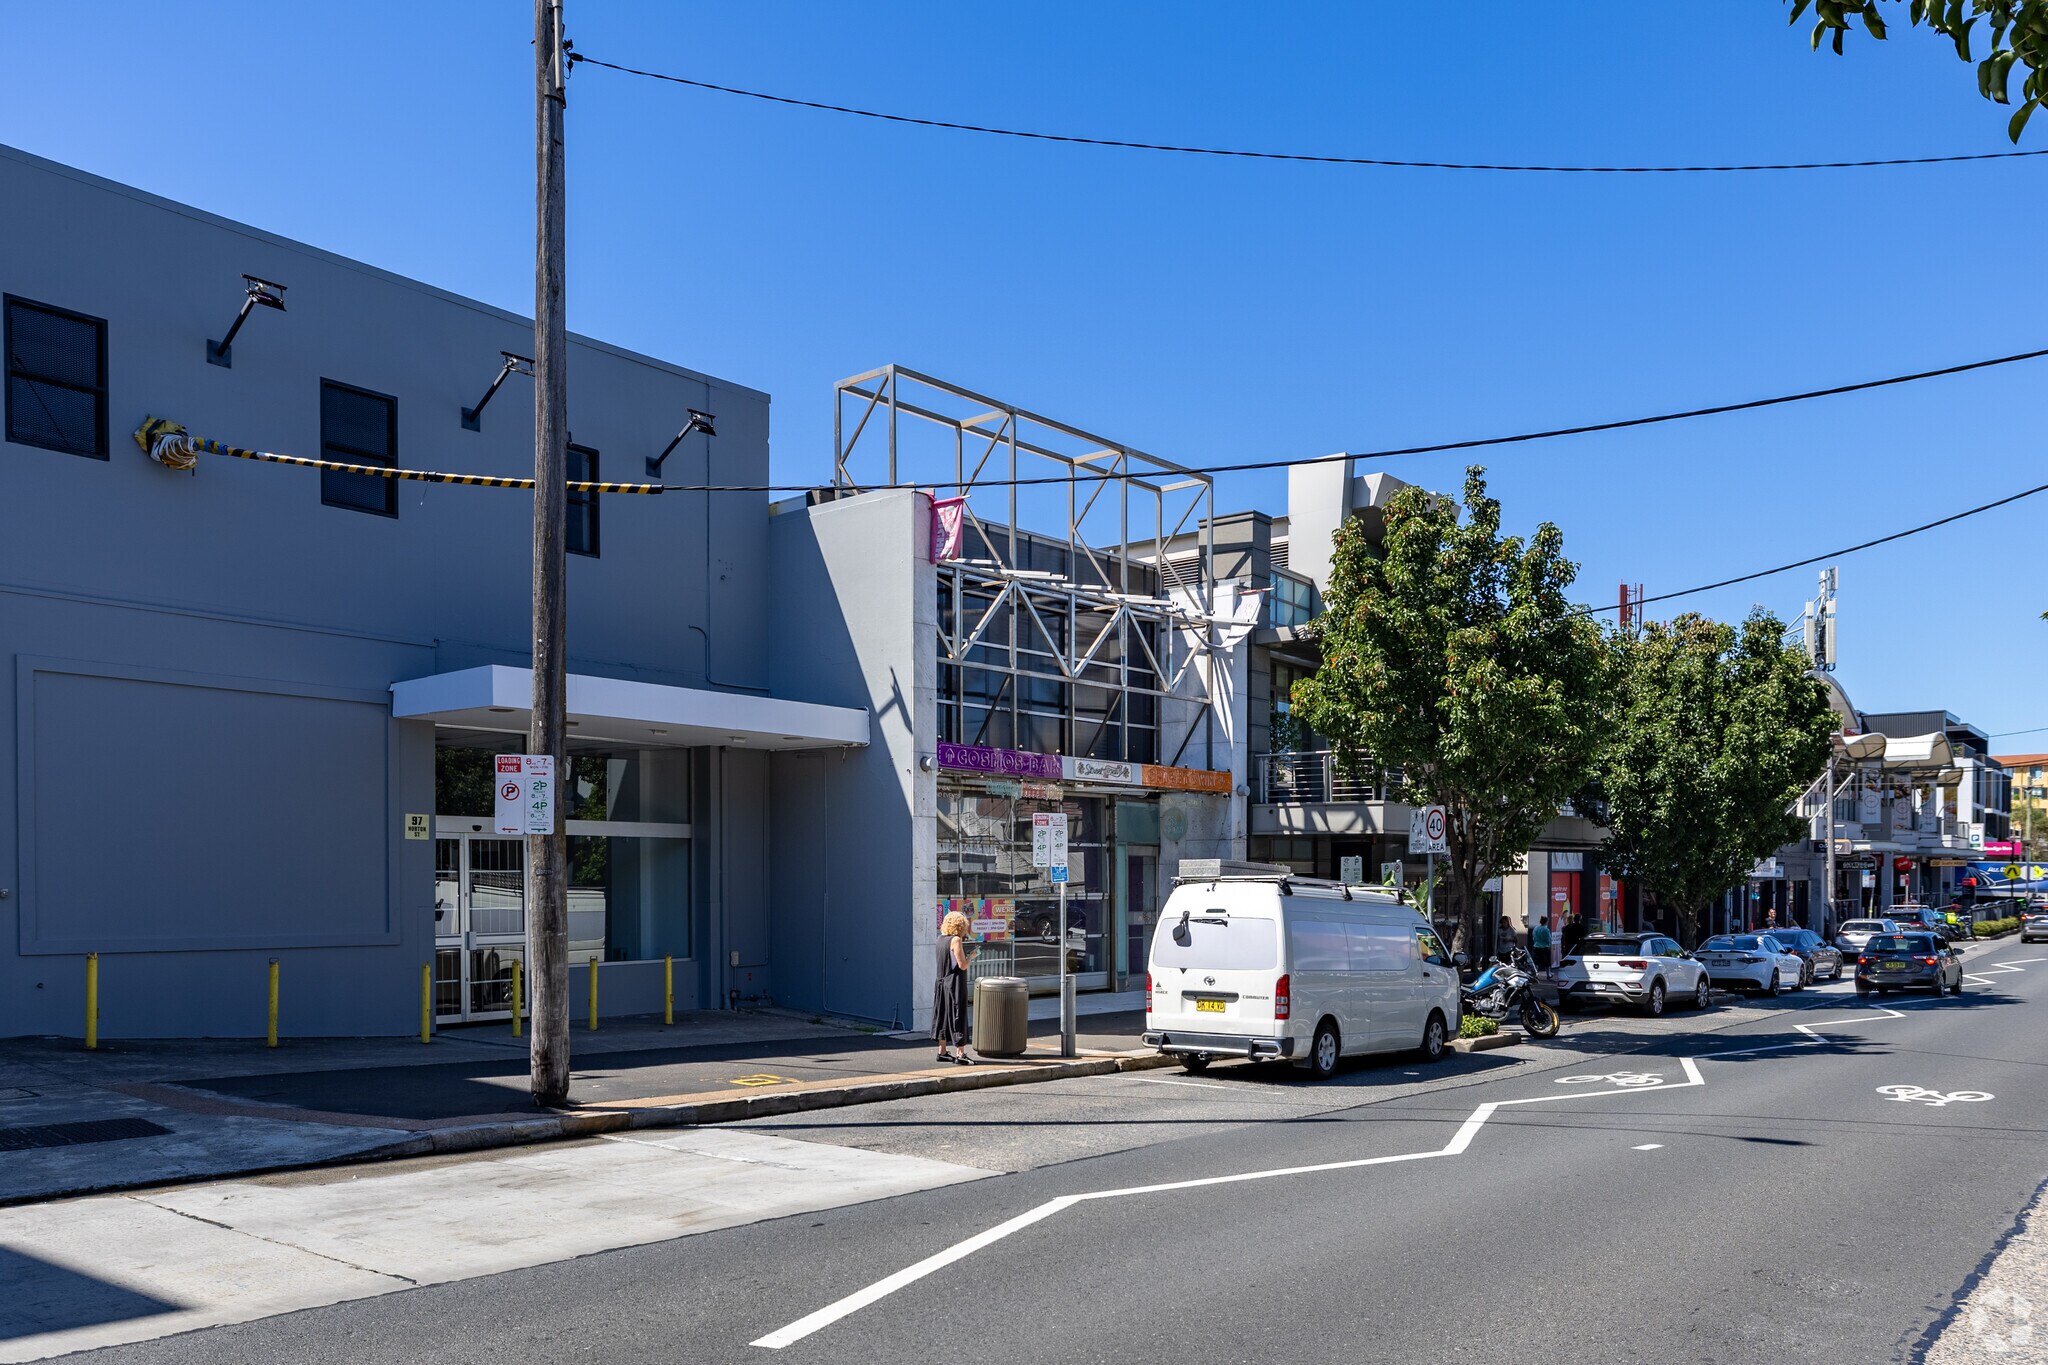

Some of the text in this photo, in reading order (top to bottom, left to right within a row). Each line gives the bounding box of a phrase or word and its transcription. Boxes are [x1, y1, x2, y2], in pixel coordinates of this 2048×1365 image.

[533, 782, 547, 790] 2P
[532, 802, 547, 810] 4P
[412, 816, 422, 825] 97
[1430, 819, 1441, 831] 40
